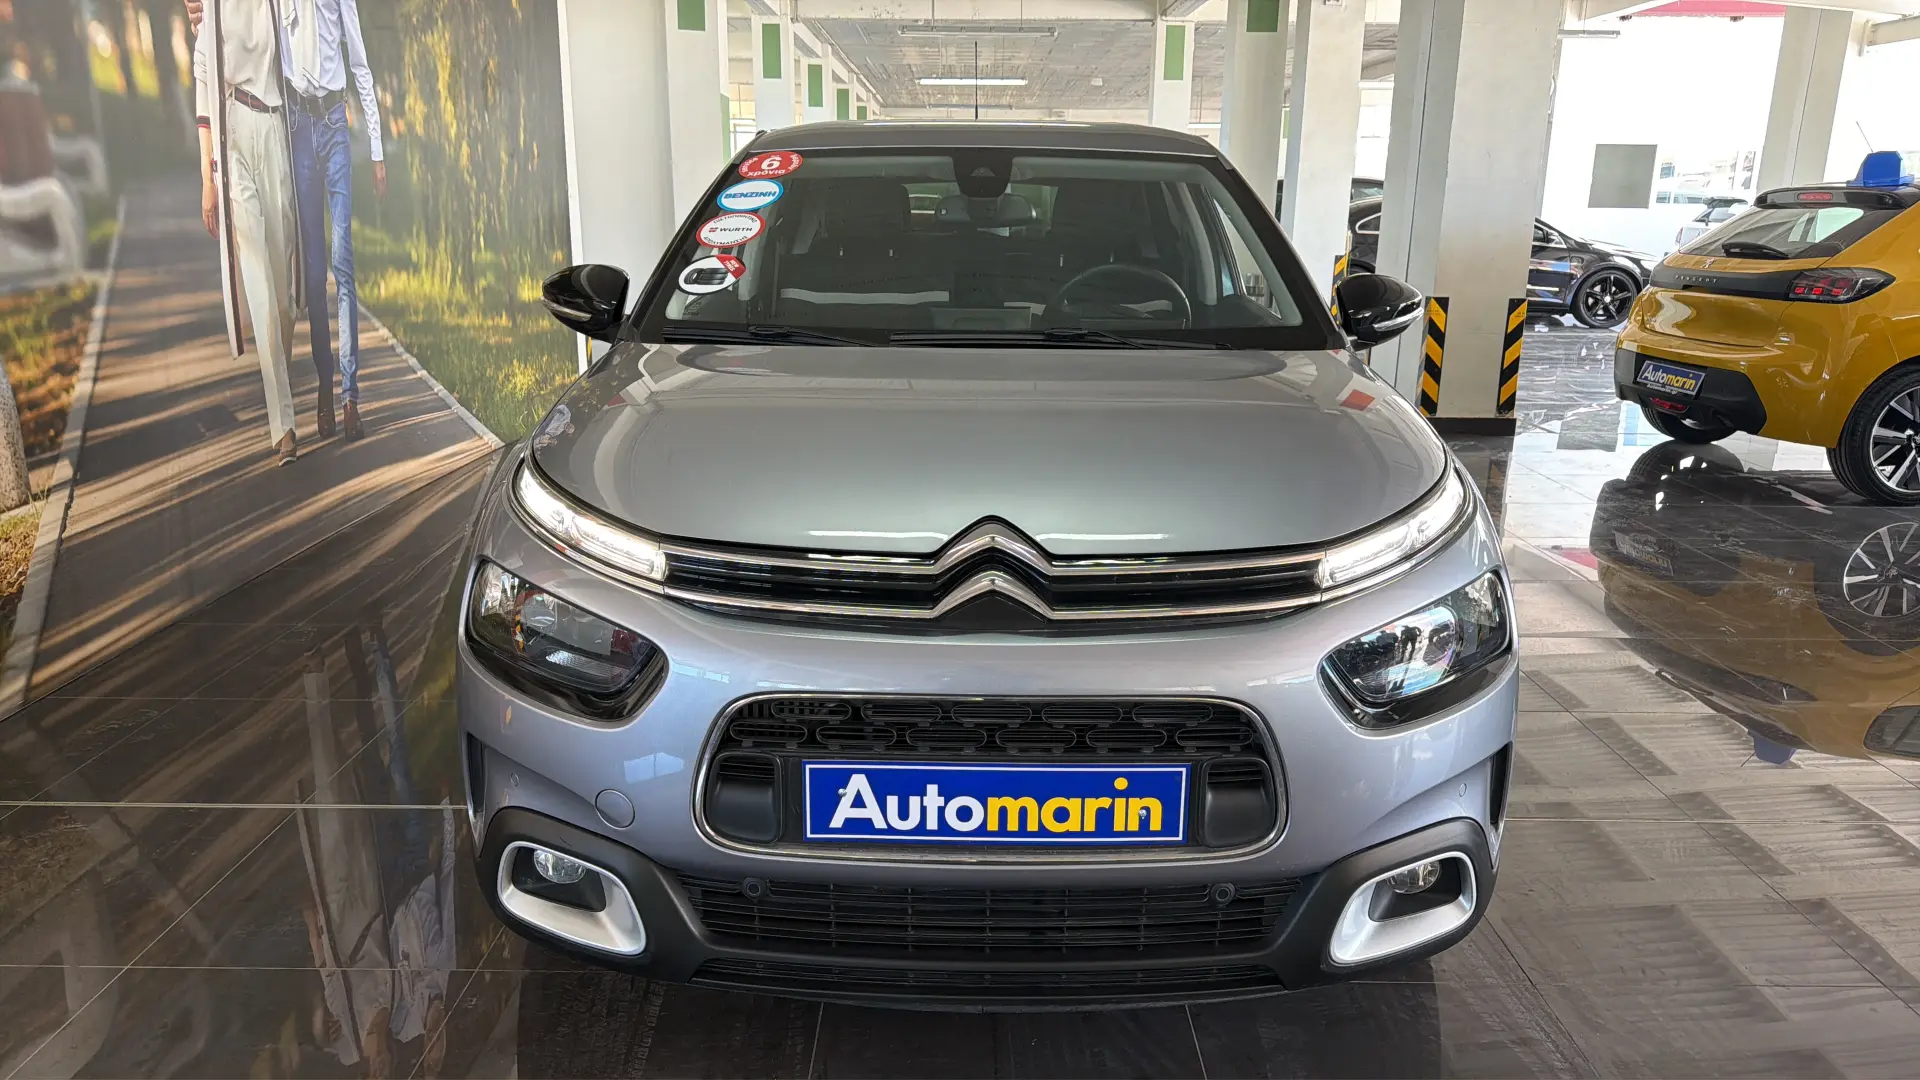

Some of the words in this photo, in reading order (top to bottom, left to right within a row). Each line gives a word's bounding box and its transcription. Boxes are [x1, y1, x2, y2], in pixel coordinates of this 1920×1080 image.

[747, 169, 786, 177] χρόνια
[761, 157, 782, 170] 6
[1641, 364, 1696, 390] Automarin
[828, 773, 1163, 833] Automarin
